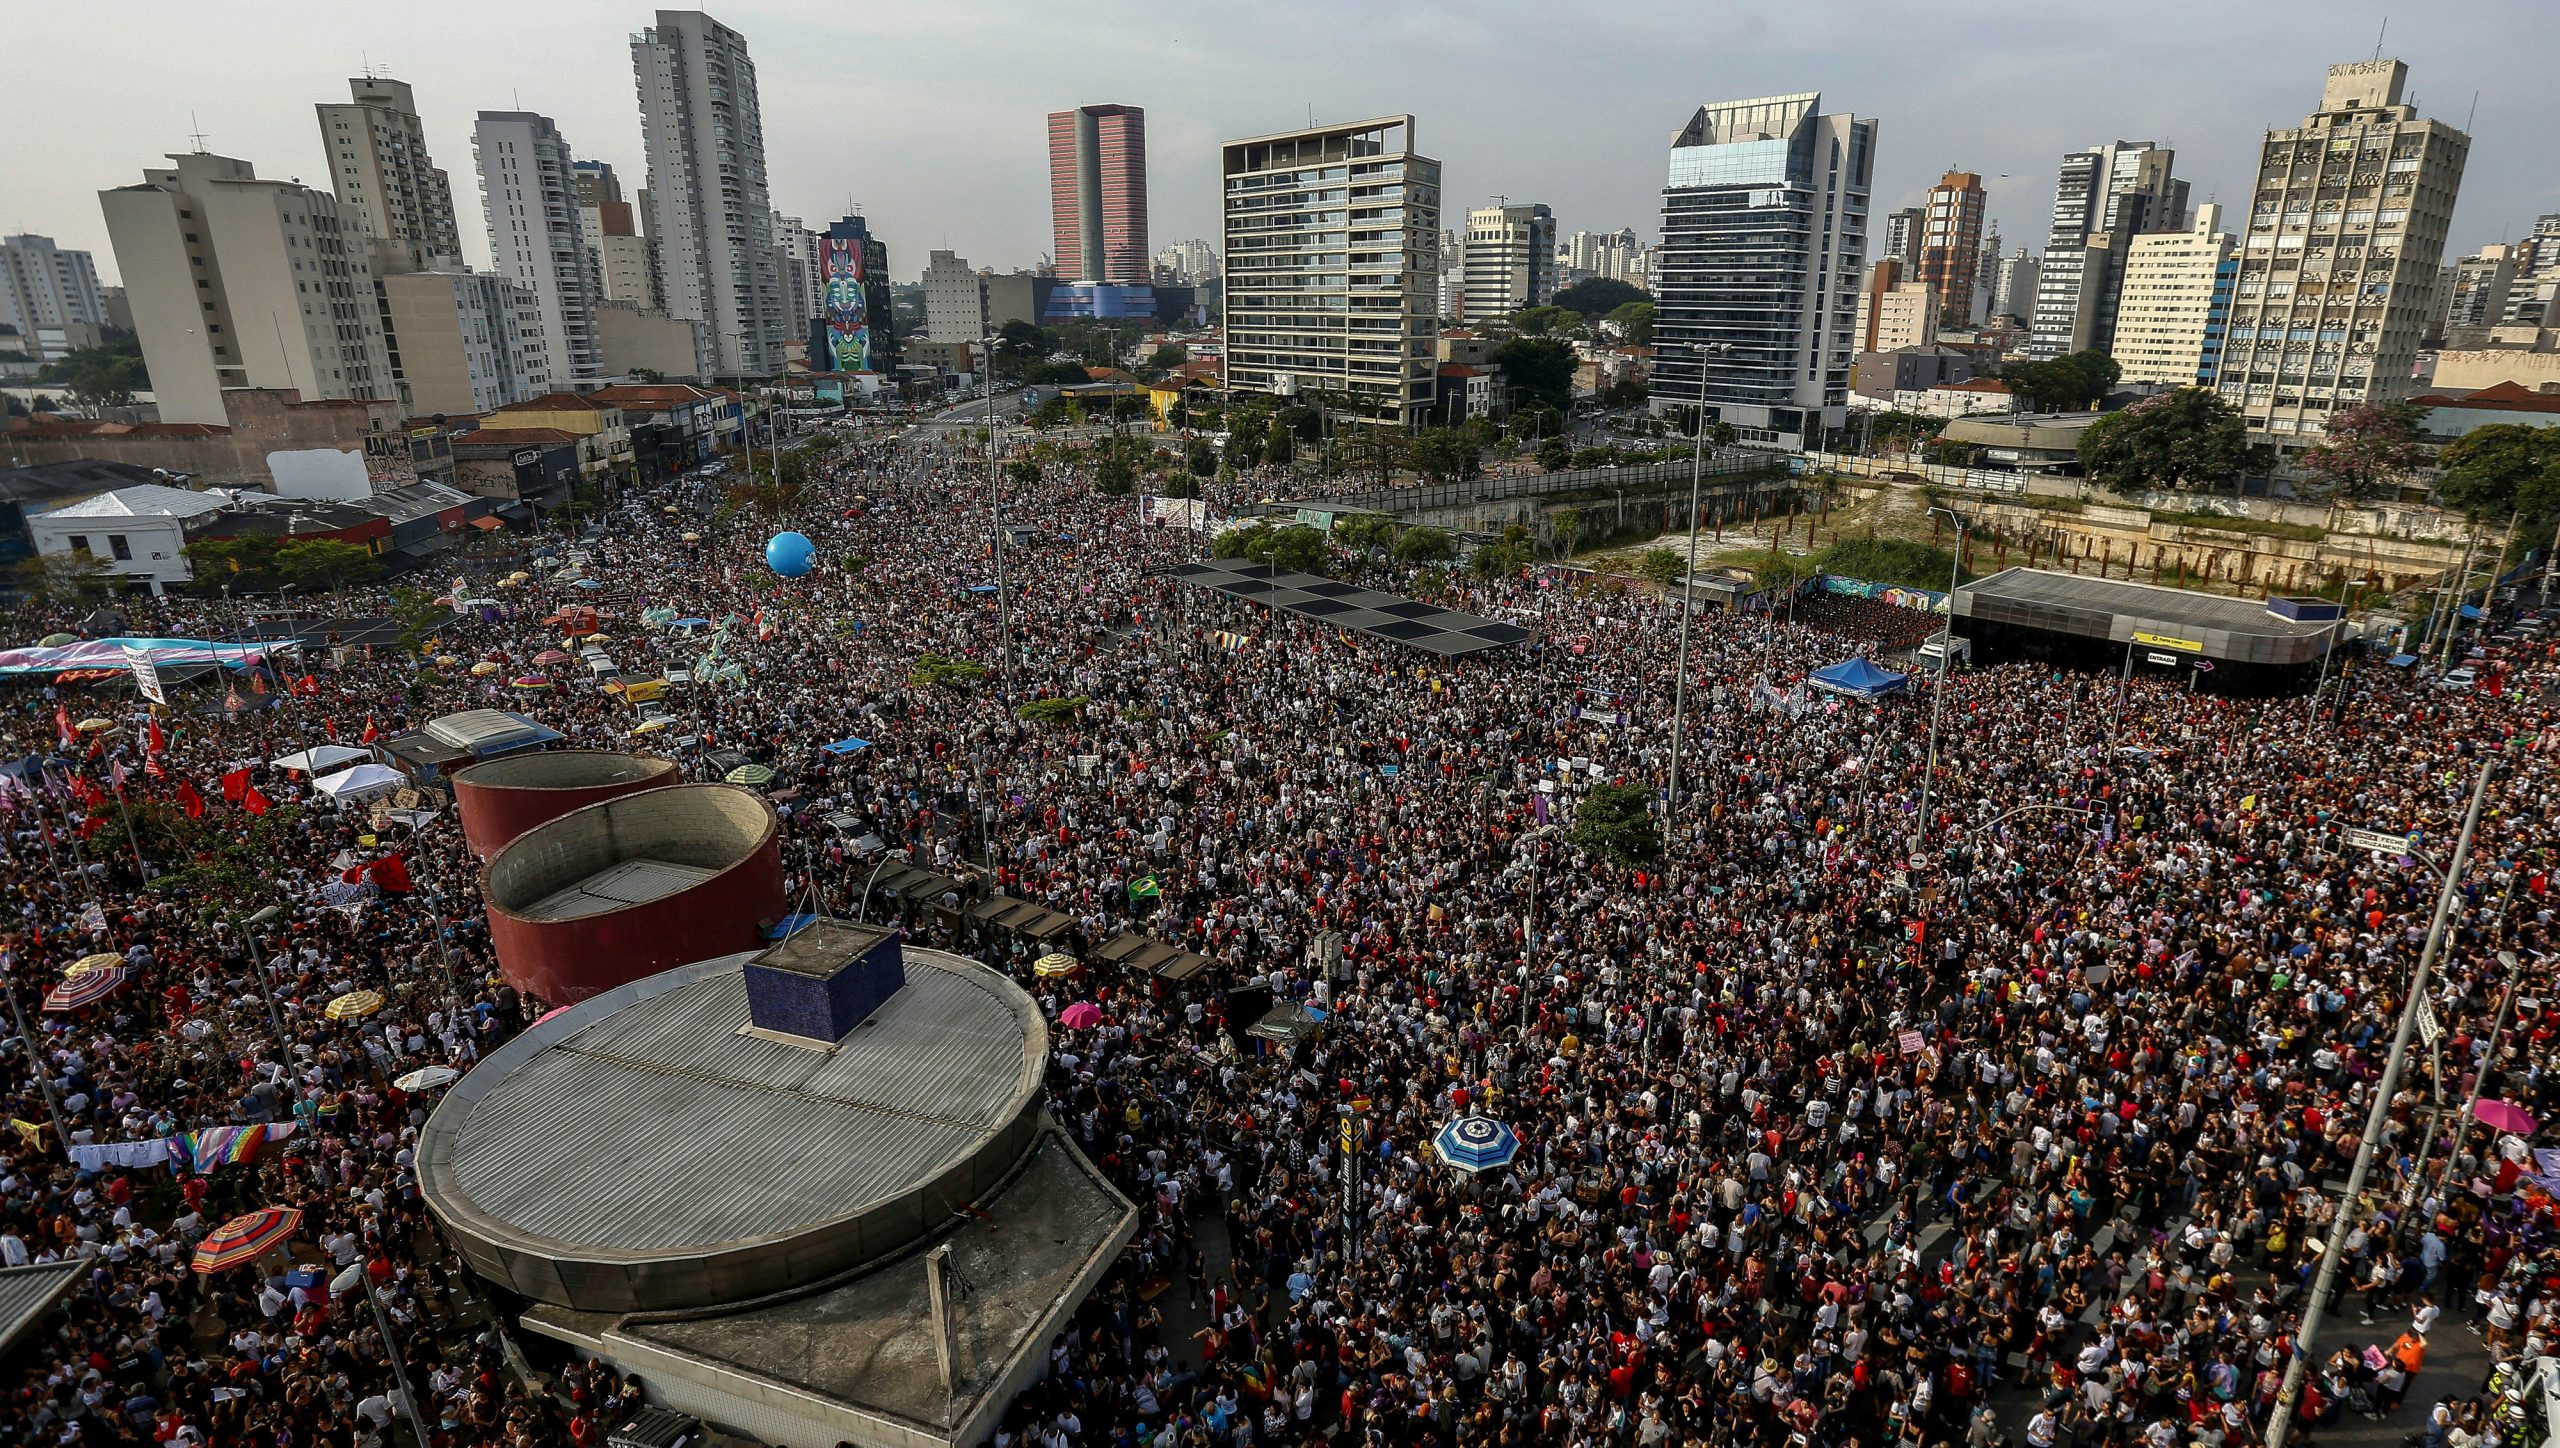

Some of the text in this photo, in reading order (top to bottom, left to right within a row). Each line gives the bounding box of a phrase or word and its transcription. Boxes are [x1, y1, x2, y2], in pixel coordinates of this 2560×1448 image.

[2149, 655, 2175, 664] ENTRADA
[2352, 831, 2405, 846] NUNCA FECHE
[2359, 840, 2406, 853] CRUZAMENTO
[1342, 1157, 1350, 1212] Faria Lima
